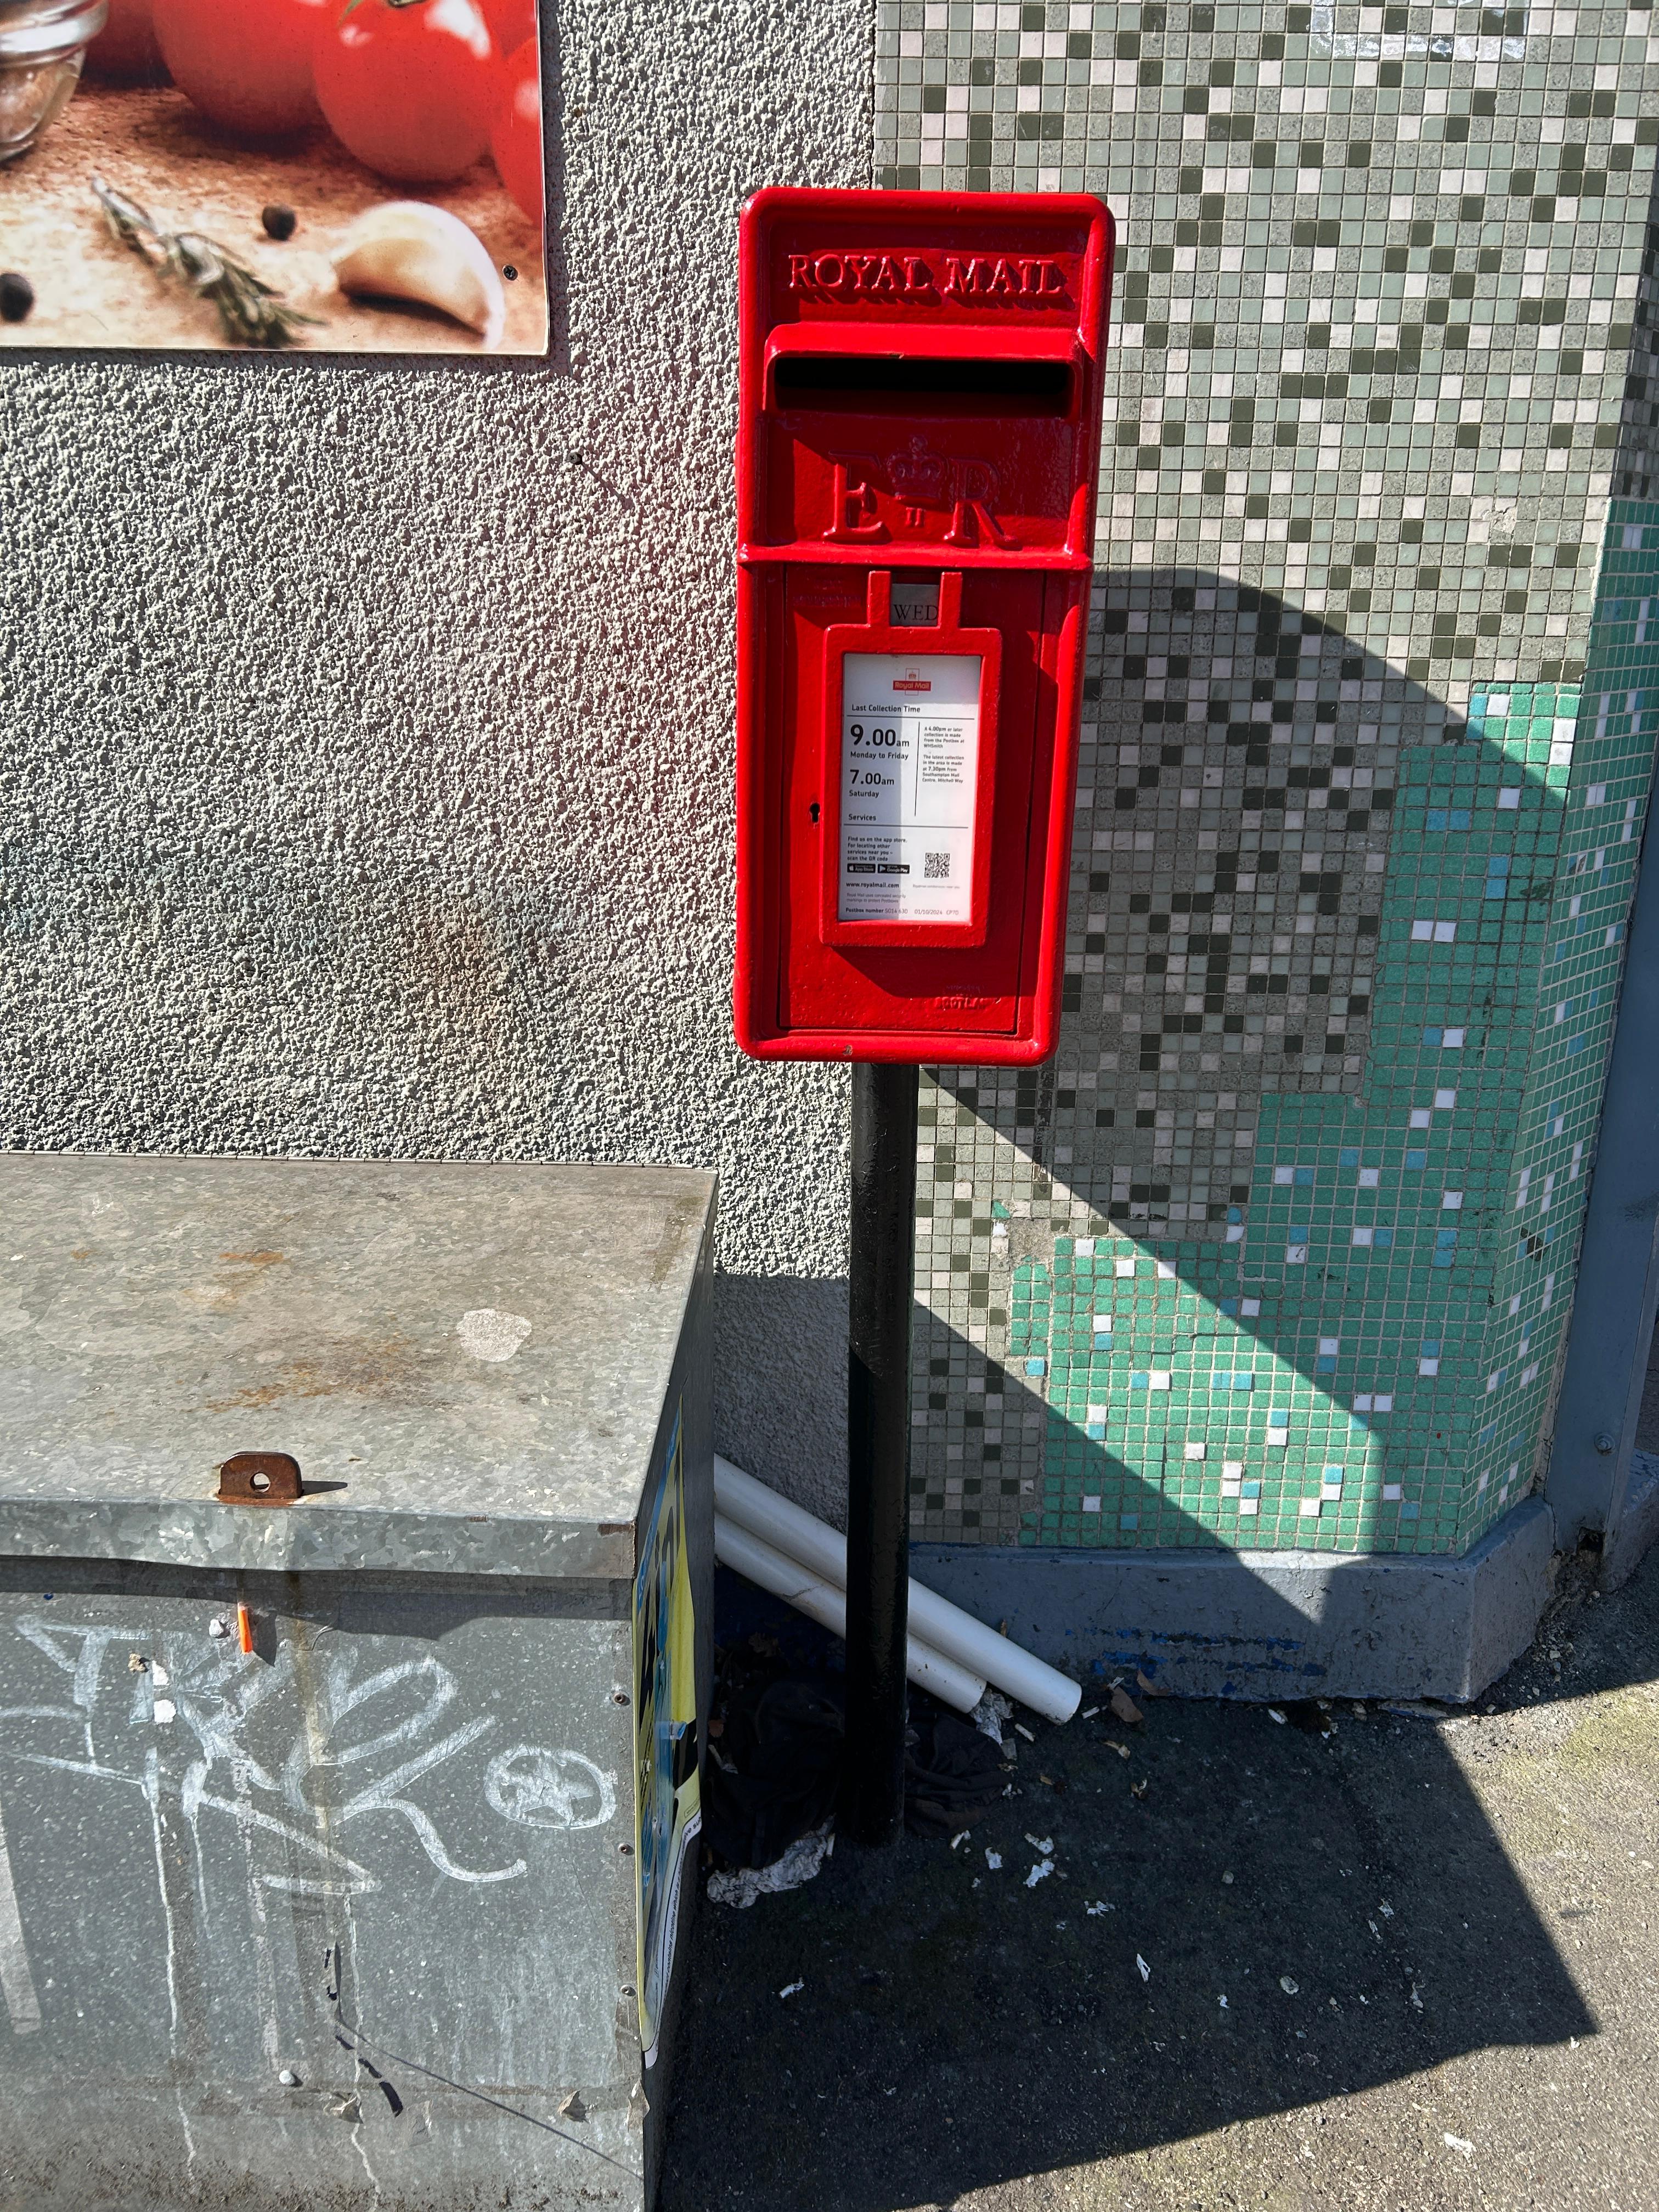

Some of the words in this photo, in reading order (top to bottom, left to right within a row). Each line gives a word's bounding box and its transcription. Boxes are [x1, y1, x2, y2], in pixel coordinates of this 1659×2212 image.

[789, 255, 930, 292] ROYAL
[944, 257, 1063, 295] MAIL
[823, 449, 887, 543] E
[906, 506, 926, 528] II
[944, 456, 1019, 547] R
[893, 604, 939, 621] WED
[850, 724, 910, 747] 9.00am
[850, 751, 877, 759] Monday
[888, 752, 909, 760] Friday
[850, 769, 894, 785] 7.00am
[849, 789, 879, 798] Saturday
